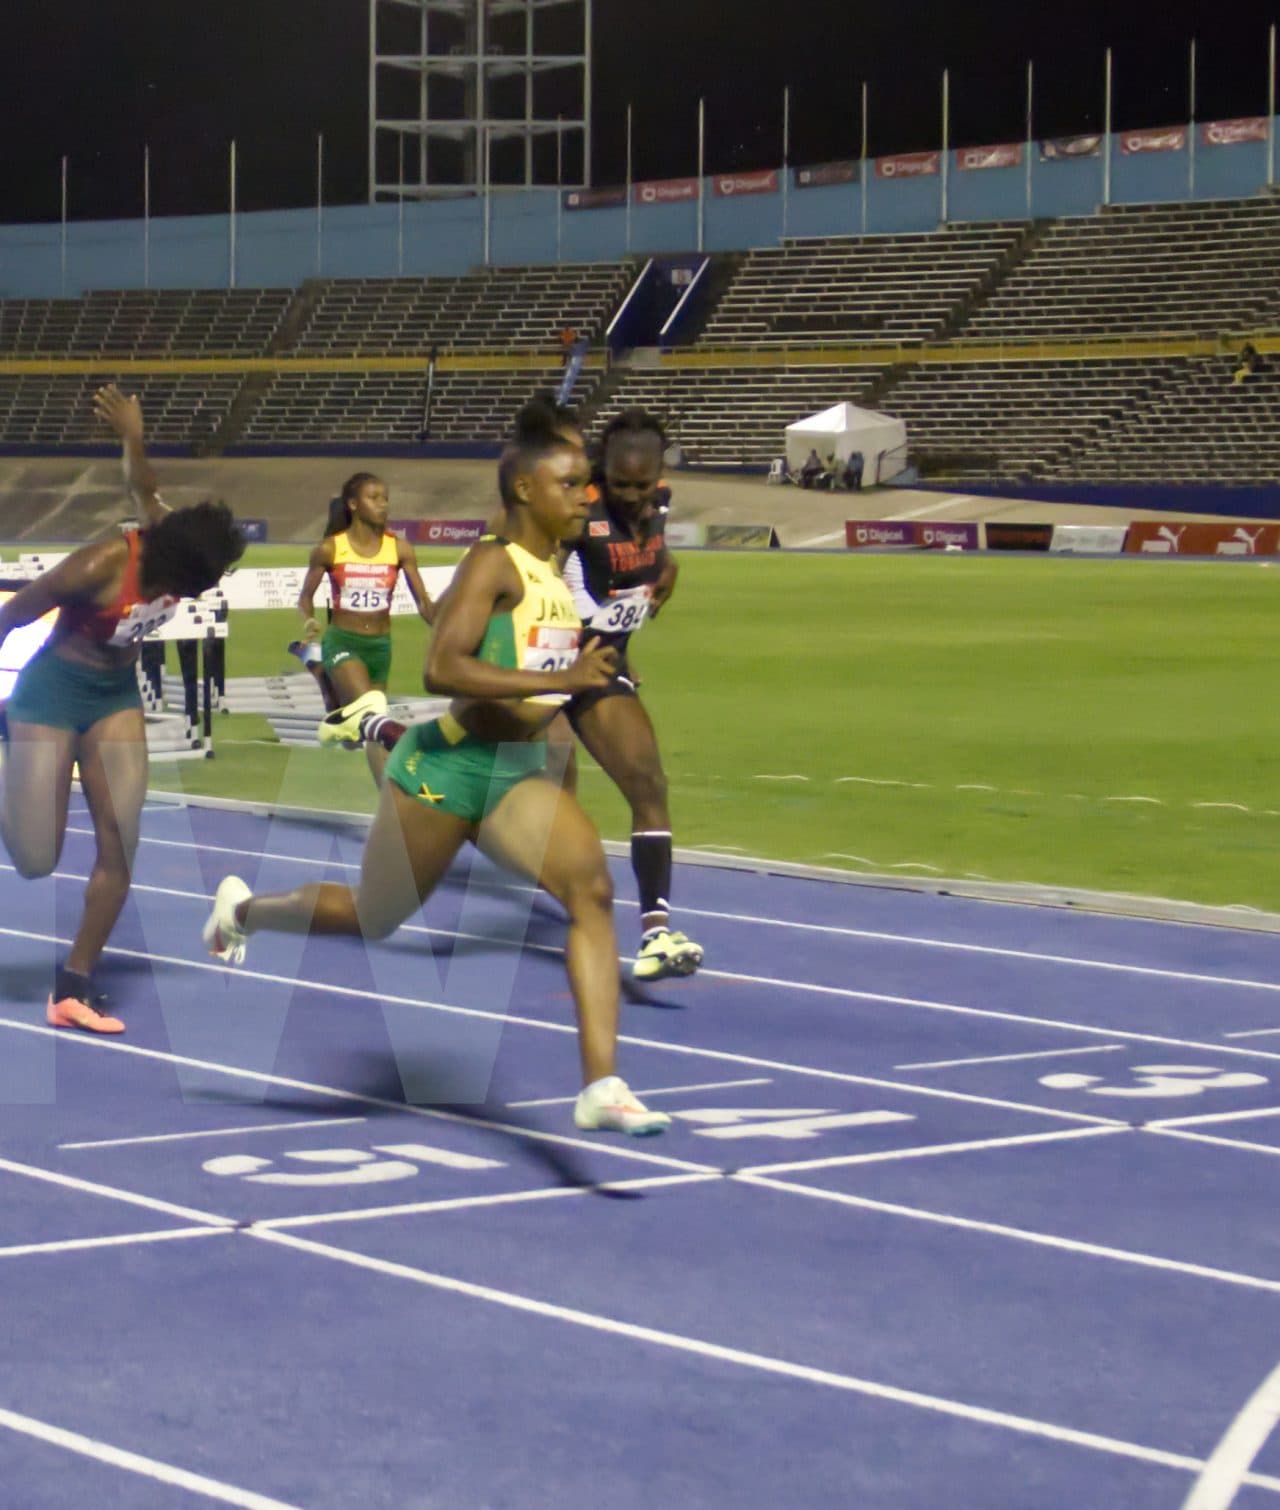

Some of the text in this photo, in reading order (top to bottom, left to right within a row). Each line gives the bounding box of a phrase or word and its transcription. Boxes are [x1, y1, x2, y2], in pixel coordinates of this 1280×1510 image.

[443, 527, 480, 539] Digicel
[350, 590, 380, 608] 215
[1037, 1064, 1269, 1098] 3
